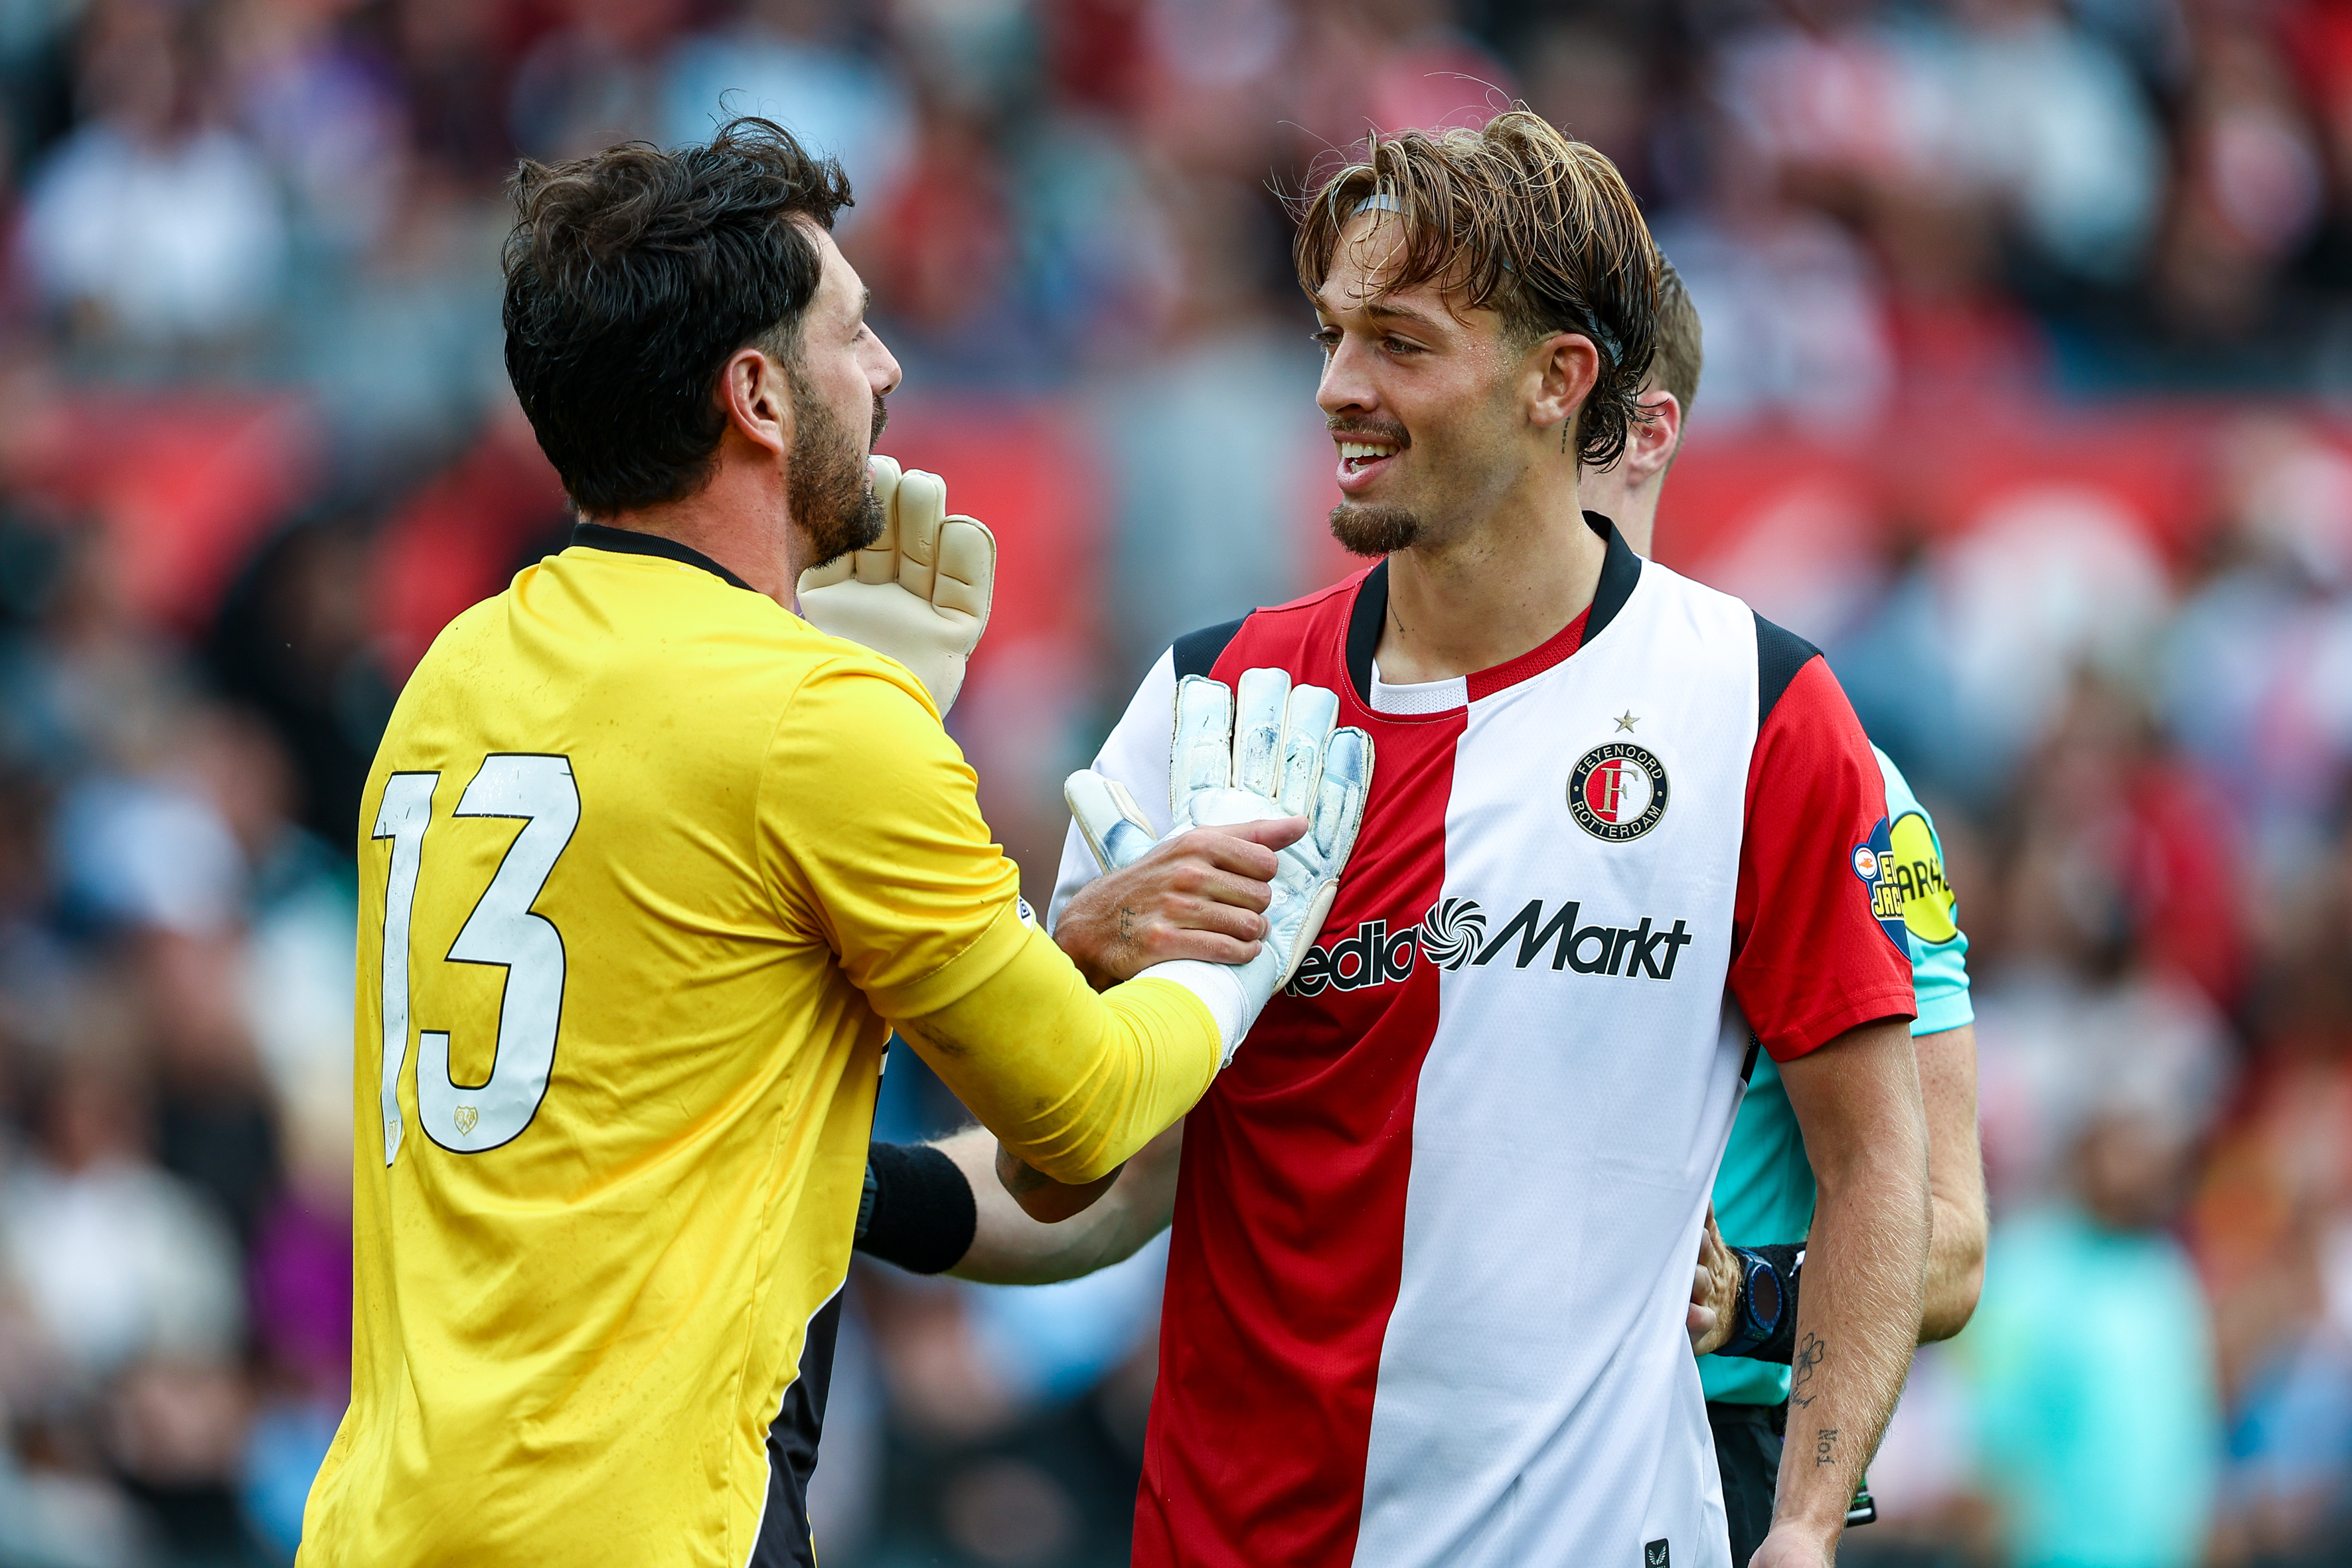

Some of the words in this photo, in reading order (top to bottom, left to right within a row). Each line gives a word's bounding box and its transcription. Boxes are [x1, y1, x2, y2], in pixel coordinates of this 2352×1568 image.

[1577, 744, 1663, 779] FEYENOORD
[1597, 767, 1639, 814] F
[1572, 800, 1662, 838] ROTTERDAM
[1873, 885, 1904, 917] JAC
[371, 753, 581, 1168] 13
[1284, 919, 1421, 998] edia
[1466, 898, 1695, 982] Markt
